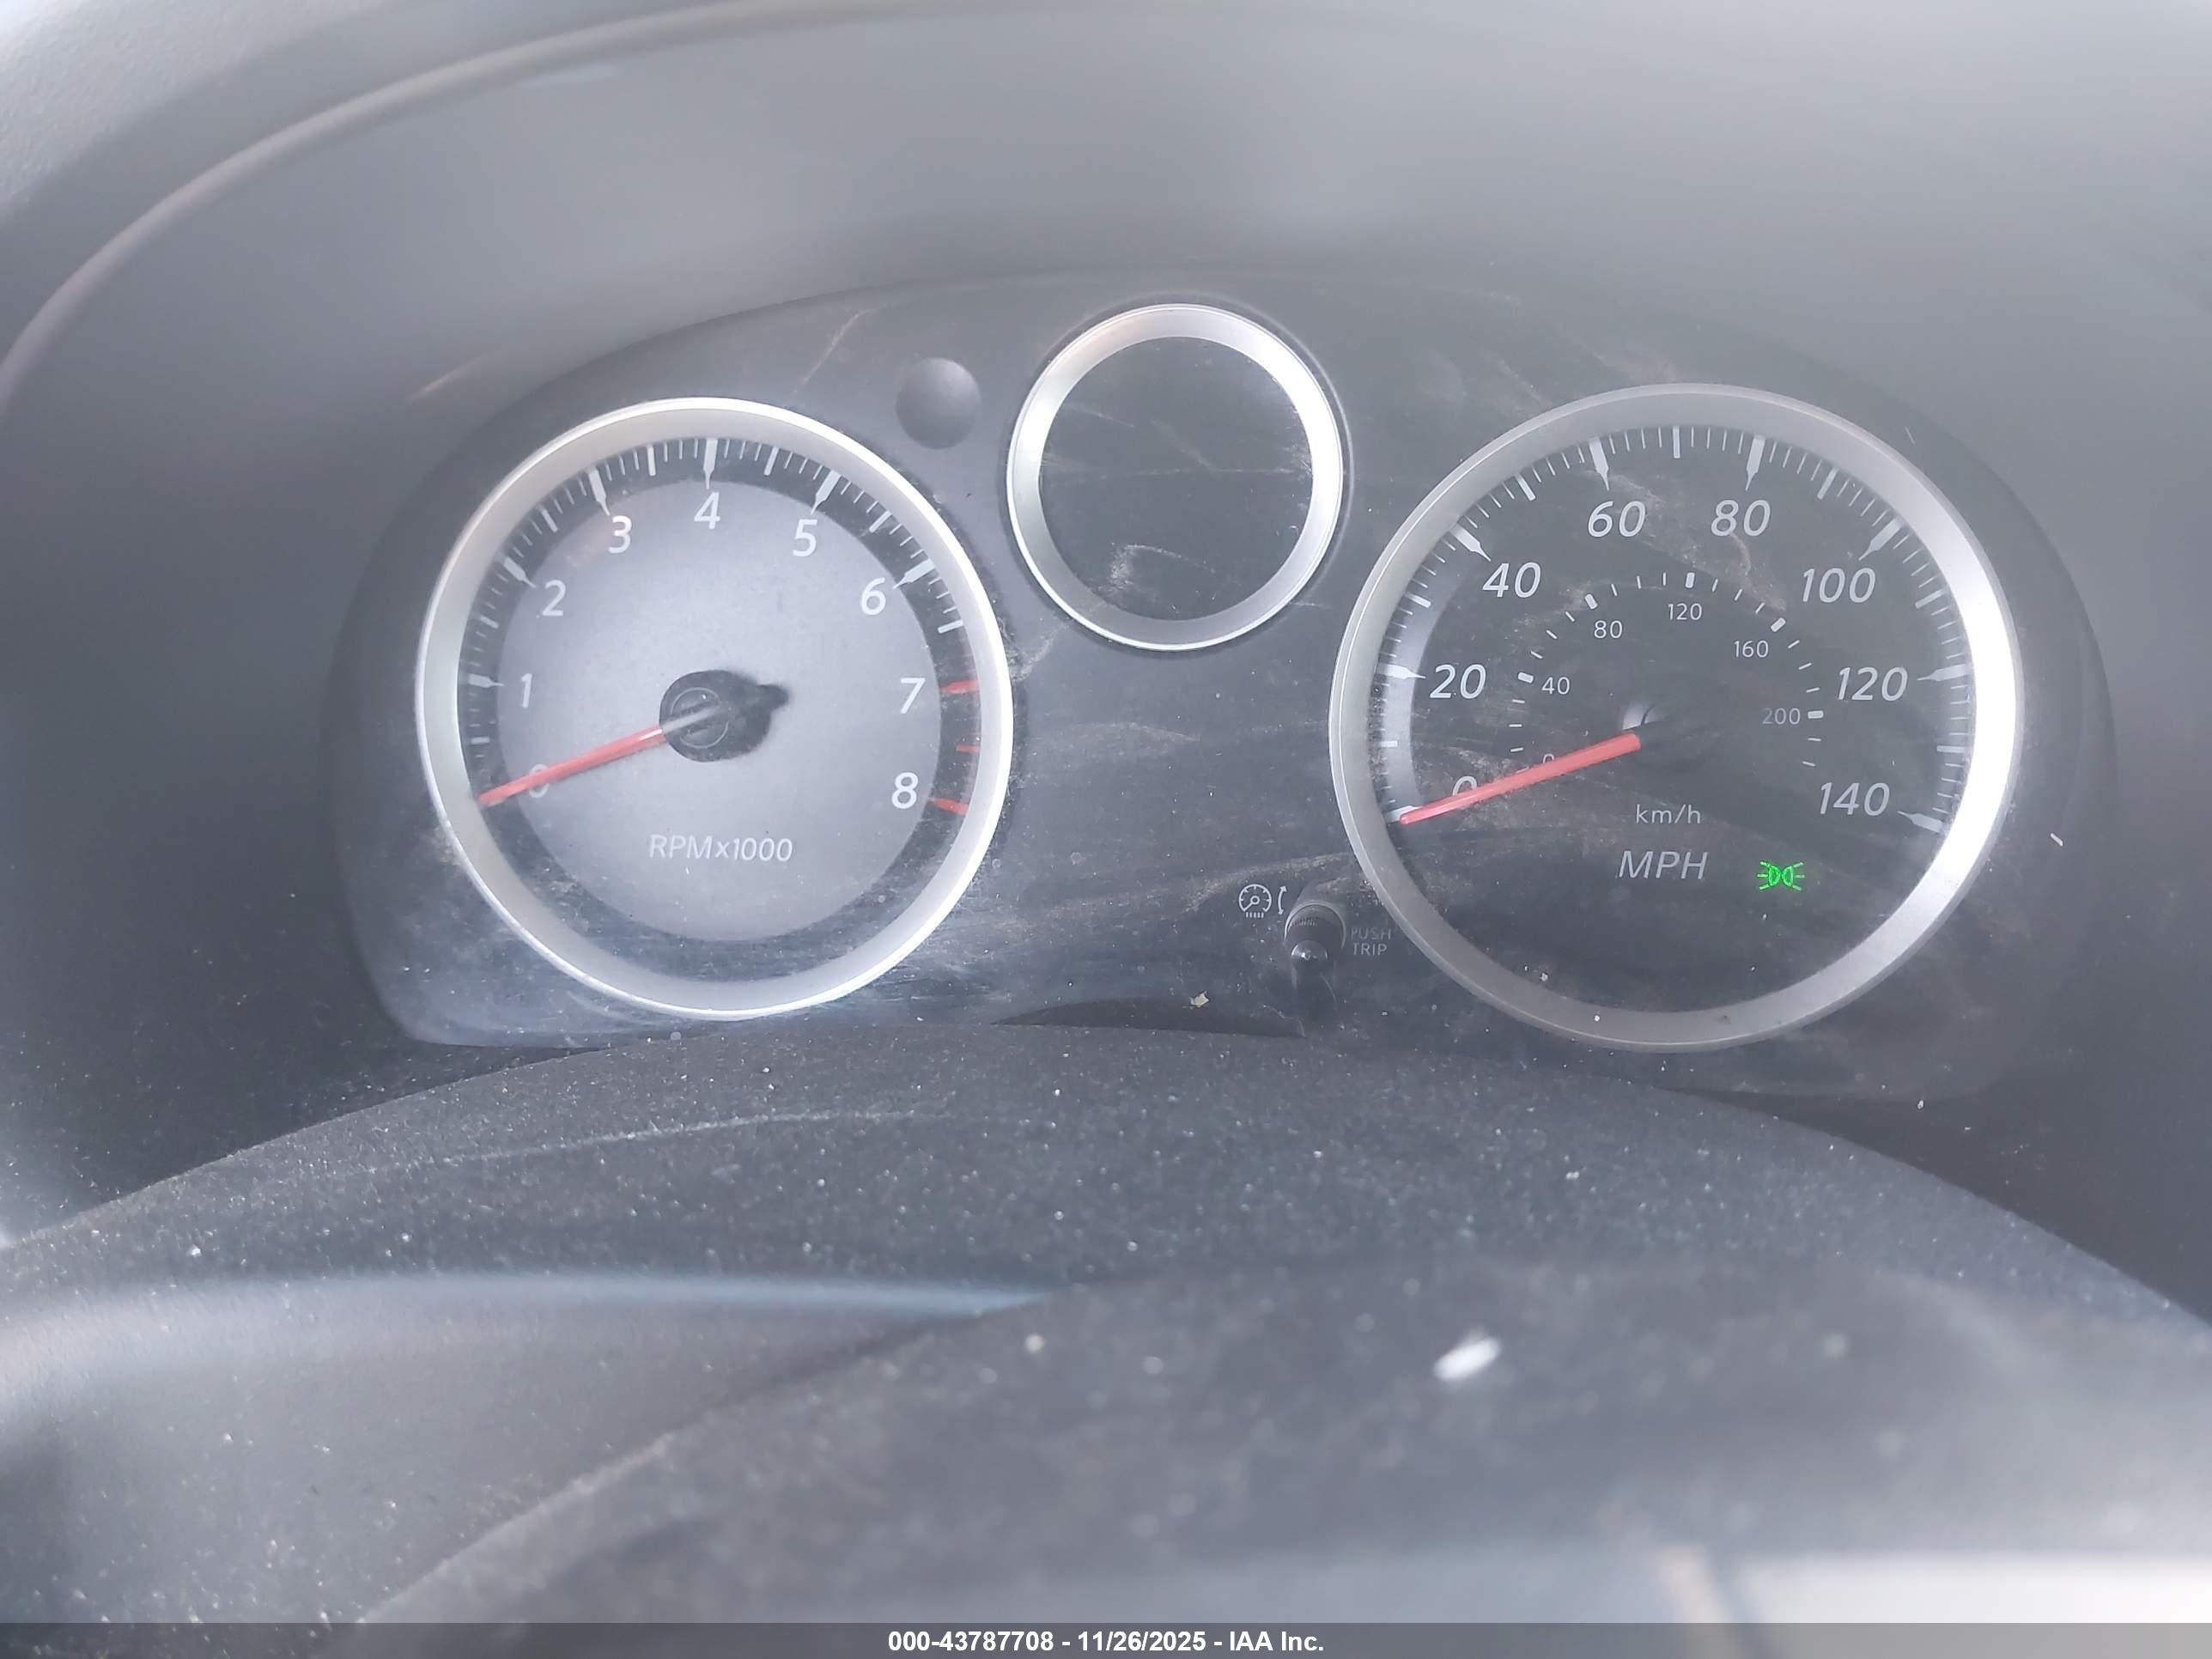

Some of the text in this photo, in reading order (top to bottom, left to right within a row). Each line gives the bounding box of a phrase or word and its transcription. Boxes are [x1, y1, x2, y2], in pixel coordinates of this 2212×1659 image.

[693, 491, 720, 530] 4
[1586, 501, 1647, 538] 60
[1710, 500, 1771, 538] 80
[609, 515, 633, 554] 3
[793, 519, 817, 556] 5
[860, 578, 887, 616] 6
[1481, 562, 1542, 599] 40
[1800, 568, 1876, 604] 100
[542, 580, 564, 617] 2
[1666, 604, 1704, 622] 120
[1594, 620, 1624, 639] 80
[1733, 641, 1770, 659] 160
[520, 673, 532, 708] 1
[899, 678, 925, 714] 7
[1429, 665, 1487, 700] 20
[1540, 677, 1571, 696] 40
[1835, 667, 1908, 702] 120
[1761, 707, 1801, 725] 200
[891, 771, 919, 809] 8
[1818, 782, 1890, 817] 140
[1634, 805, 1702, 825] km/h
[1617, 850, 1709, 879] MPH
[1351, 927, 1392, 940] PUSH
[1352, 944, 1388, 956] TRIP
